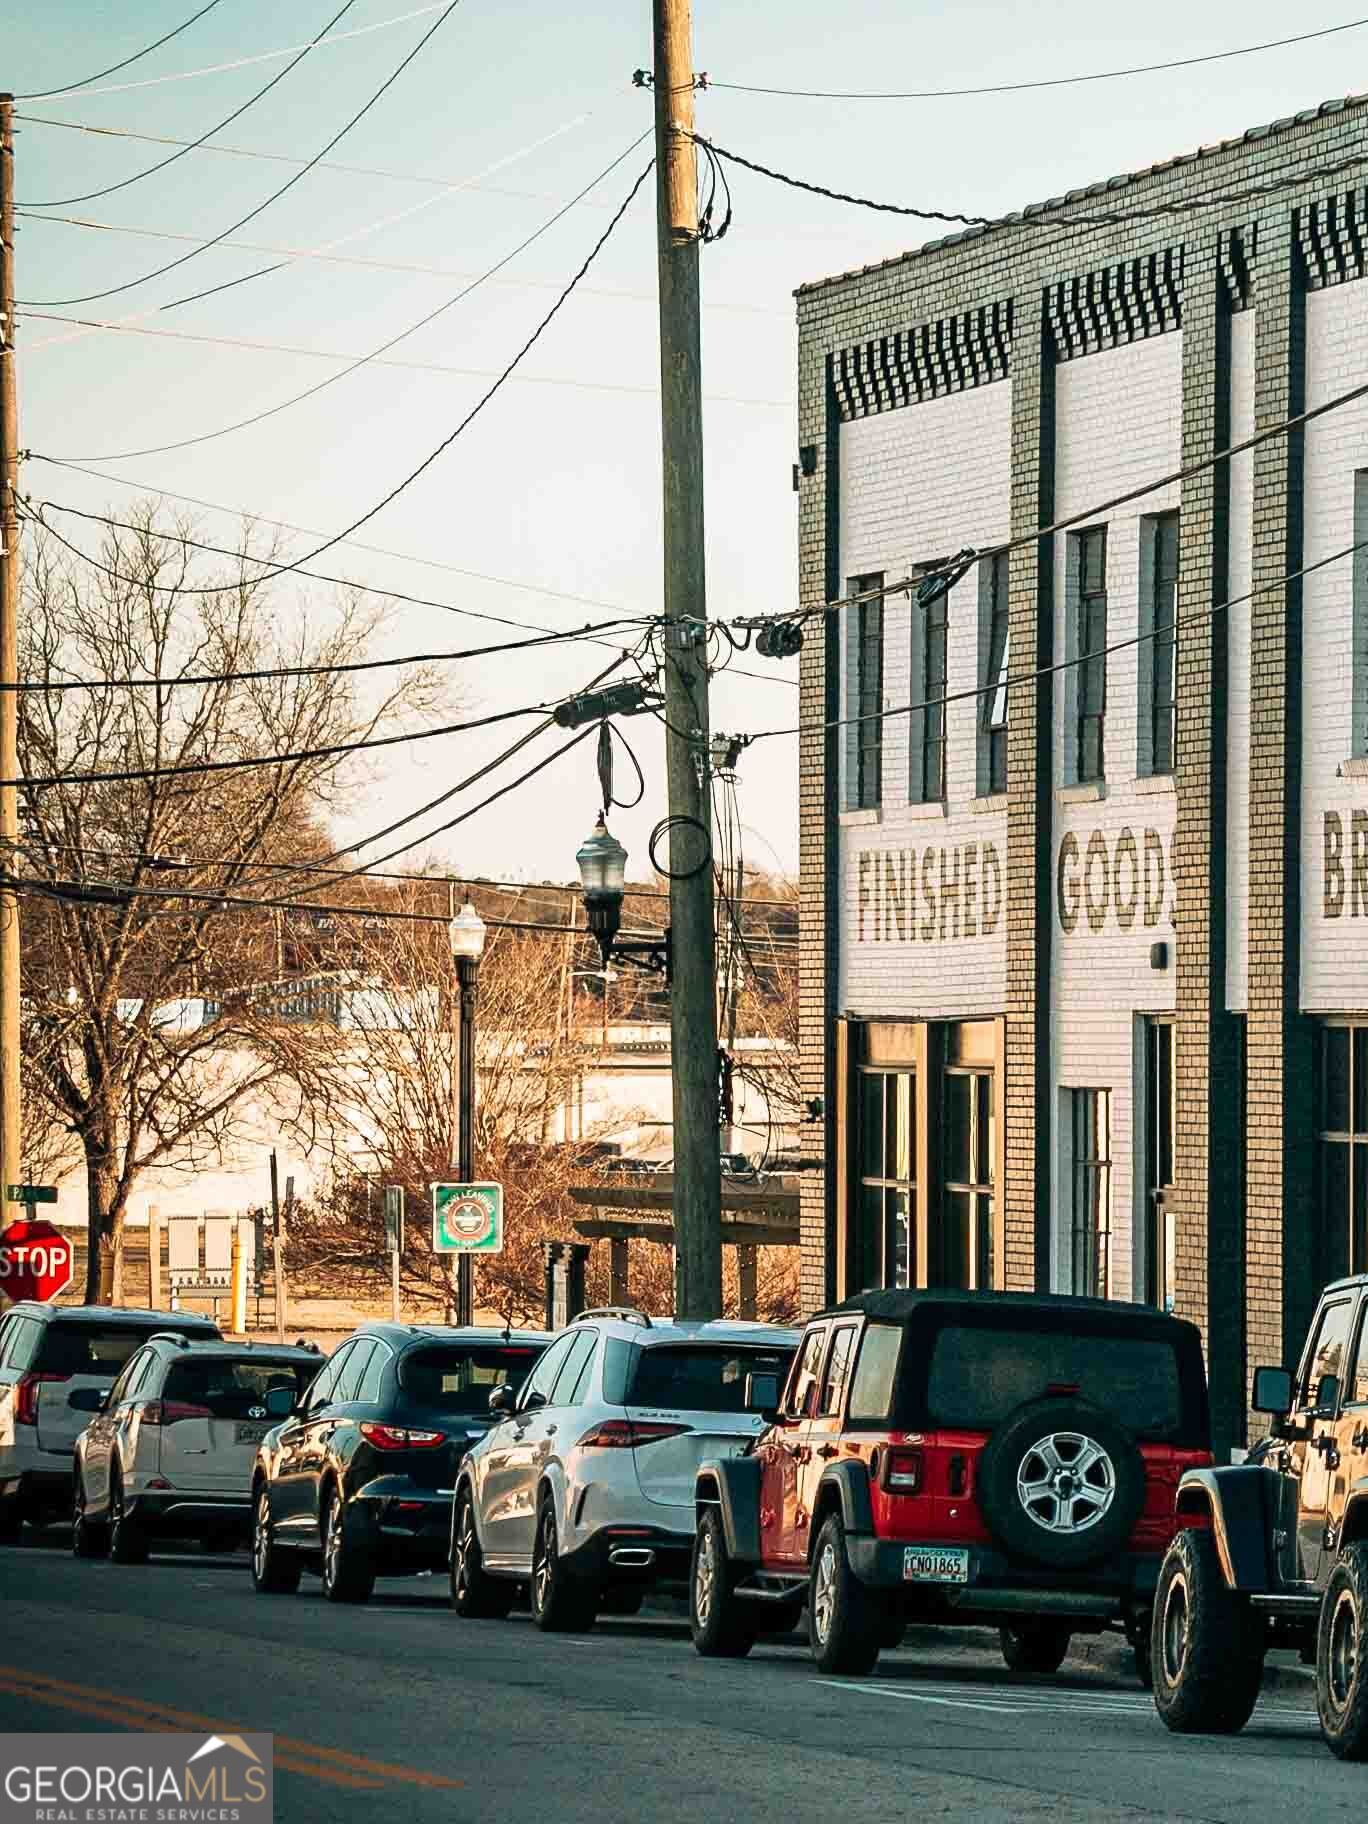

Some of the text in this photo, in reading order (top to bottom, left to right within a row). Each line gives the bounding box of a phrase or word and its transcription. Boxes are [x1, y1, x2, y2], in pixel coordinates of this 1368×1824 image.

[858, 840, 1001, 942] FINISHED
[441, 1190, 496, 1213] NOW LEAVING
[0, 1247, 67, 1278] STOP
